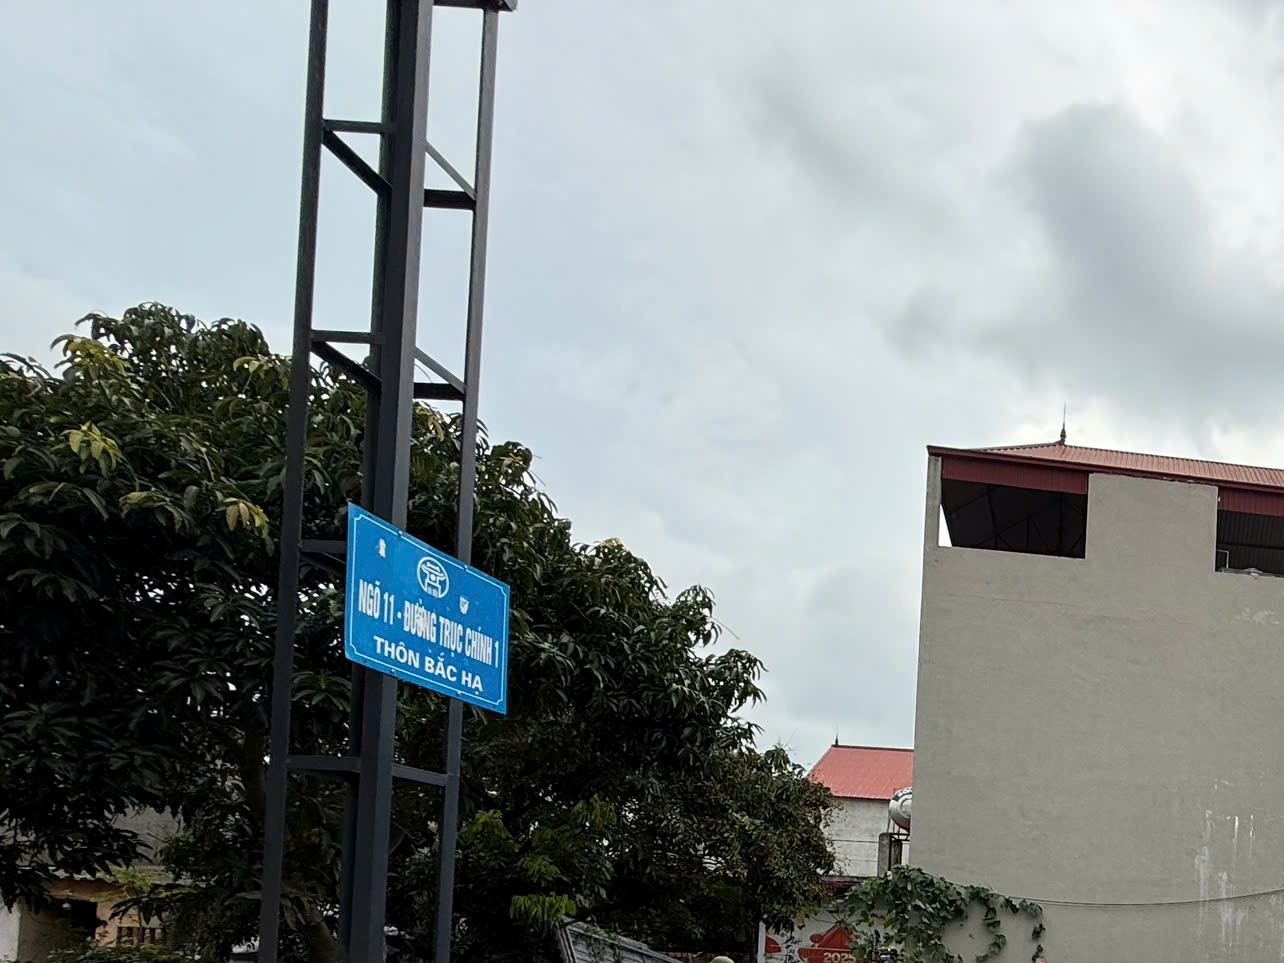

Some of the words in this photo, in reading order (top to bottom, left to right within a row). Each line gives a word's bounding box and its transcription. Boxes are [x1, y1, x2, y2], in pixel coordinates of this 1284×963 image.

[358, 579, 381, 619] NGÕ
[383, 592, 395, 625] 11
[403, 599, 437, 643] ĐƯỜNG
[439, 616, 464, 657] TRỤC
[465, 627, 493, 665] CHÍNH
[495, 640, 499, 668] 1
[373, 636, 420, 668] THÔN
[424, 650, 457, 682] BẮC
[461, 673, 484, 696] HẠ
[823, 952, 857, 963] 2025
